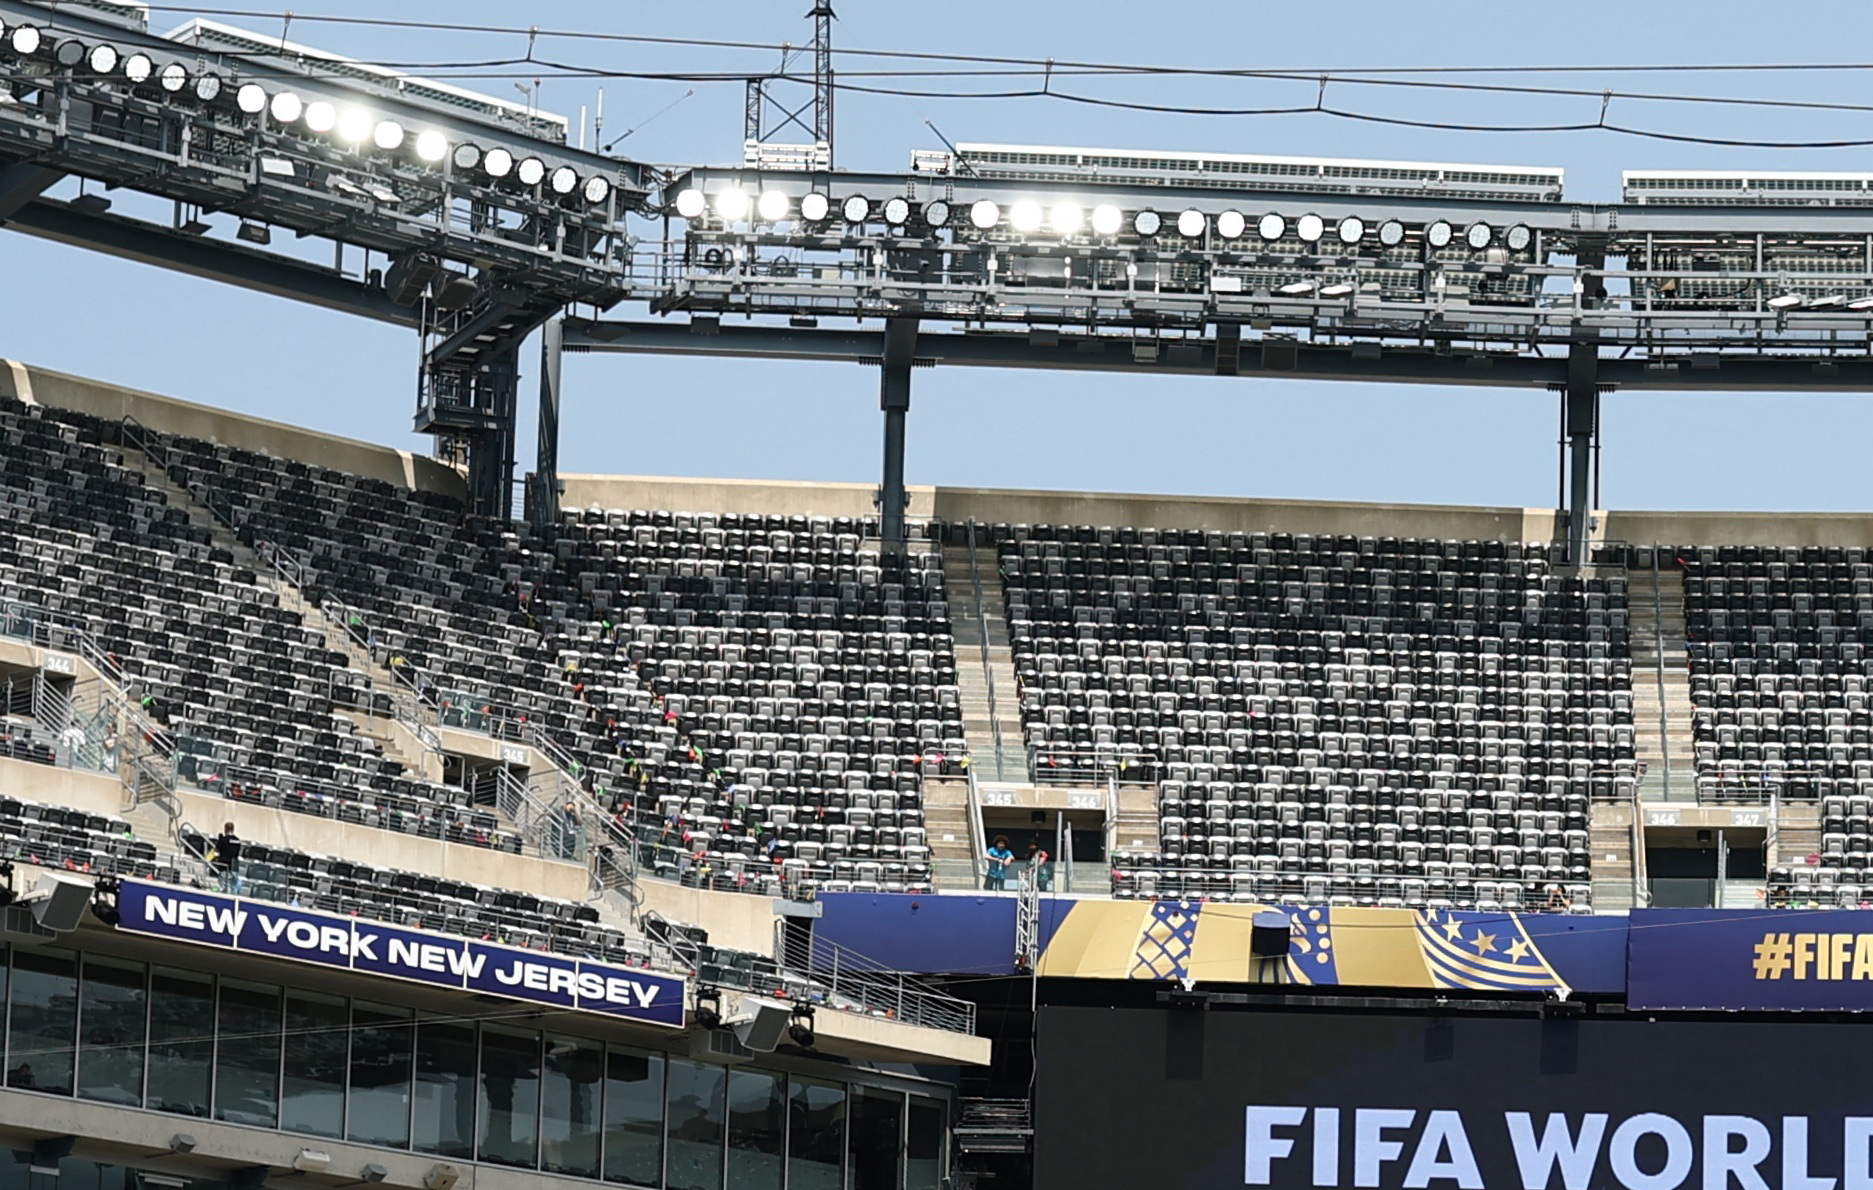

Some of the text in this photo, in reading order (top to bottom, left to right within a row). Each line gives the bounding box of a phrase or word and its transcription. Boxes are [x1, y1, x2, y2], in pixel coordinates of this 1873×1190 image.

[48, 657, 69, 673] 344
[504, 749, 524, 763] 345
[987, 793, 1012, 805] 345
[1072, 796, 1096, 808] 346
[1651, 813, 1675, 825] 346
[1735, 814, 1759, 826] 347
[145, 895, 660, 1009] NEW YORK NEW JERSEY
[1245, 1106, 1485, 1190] FIFA
